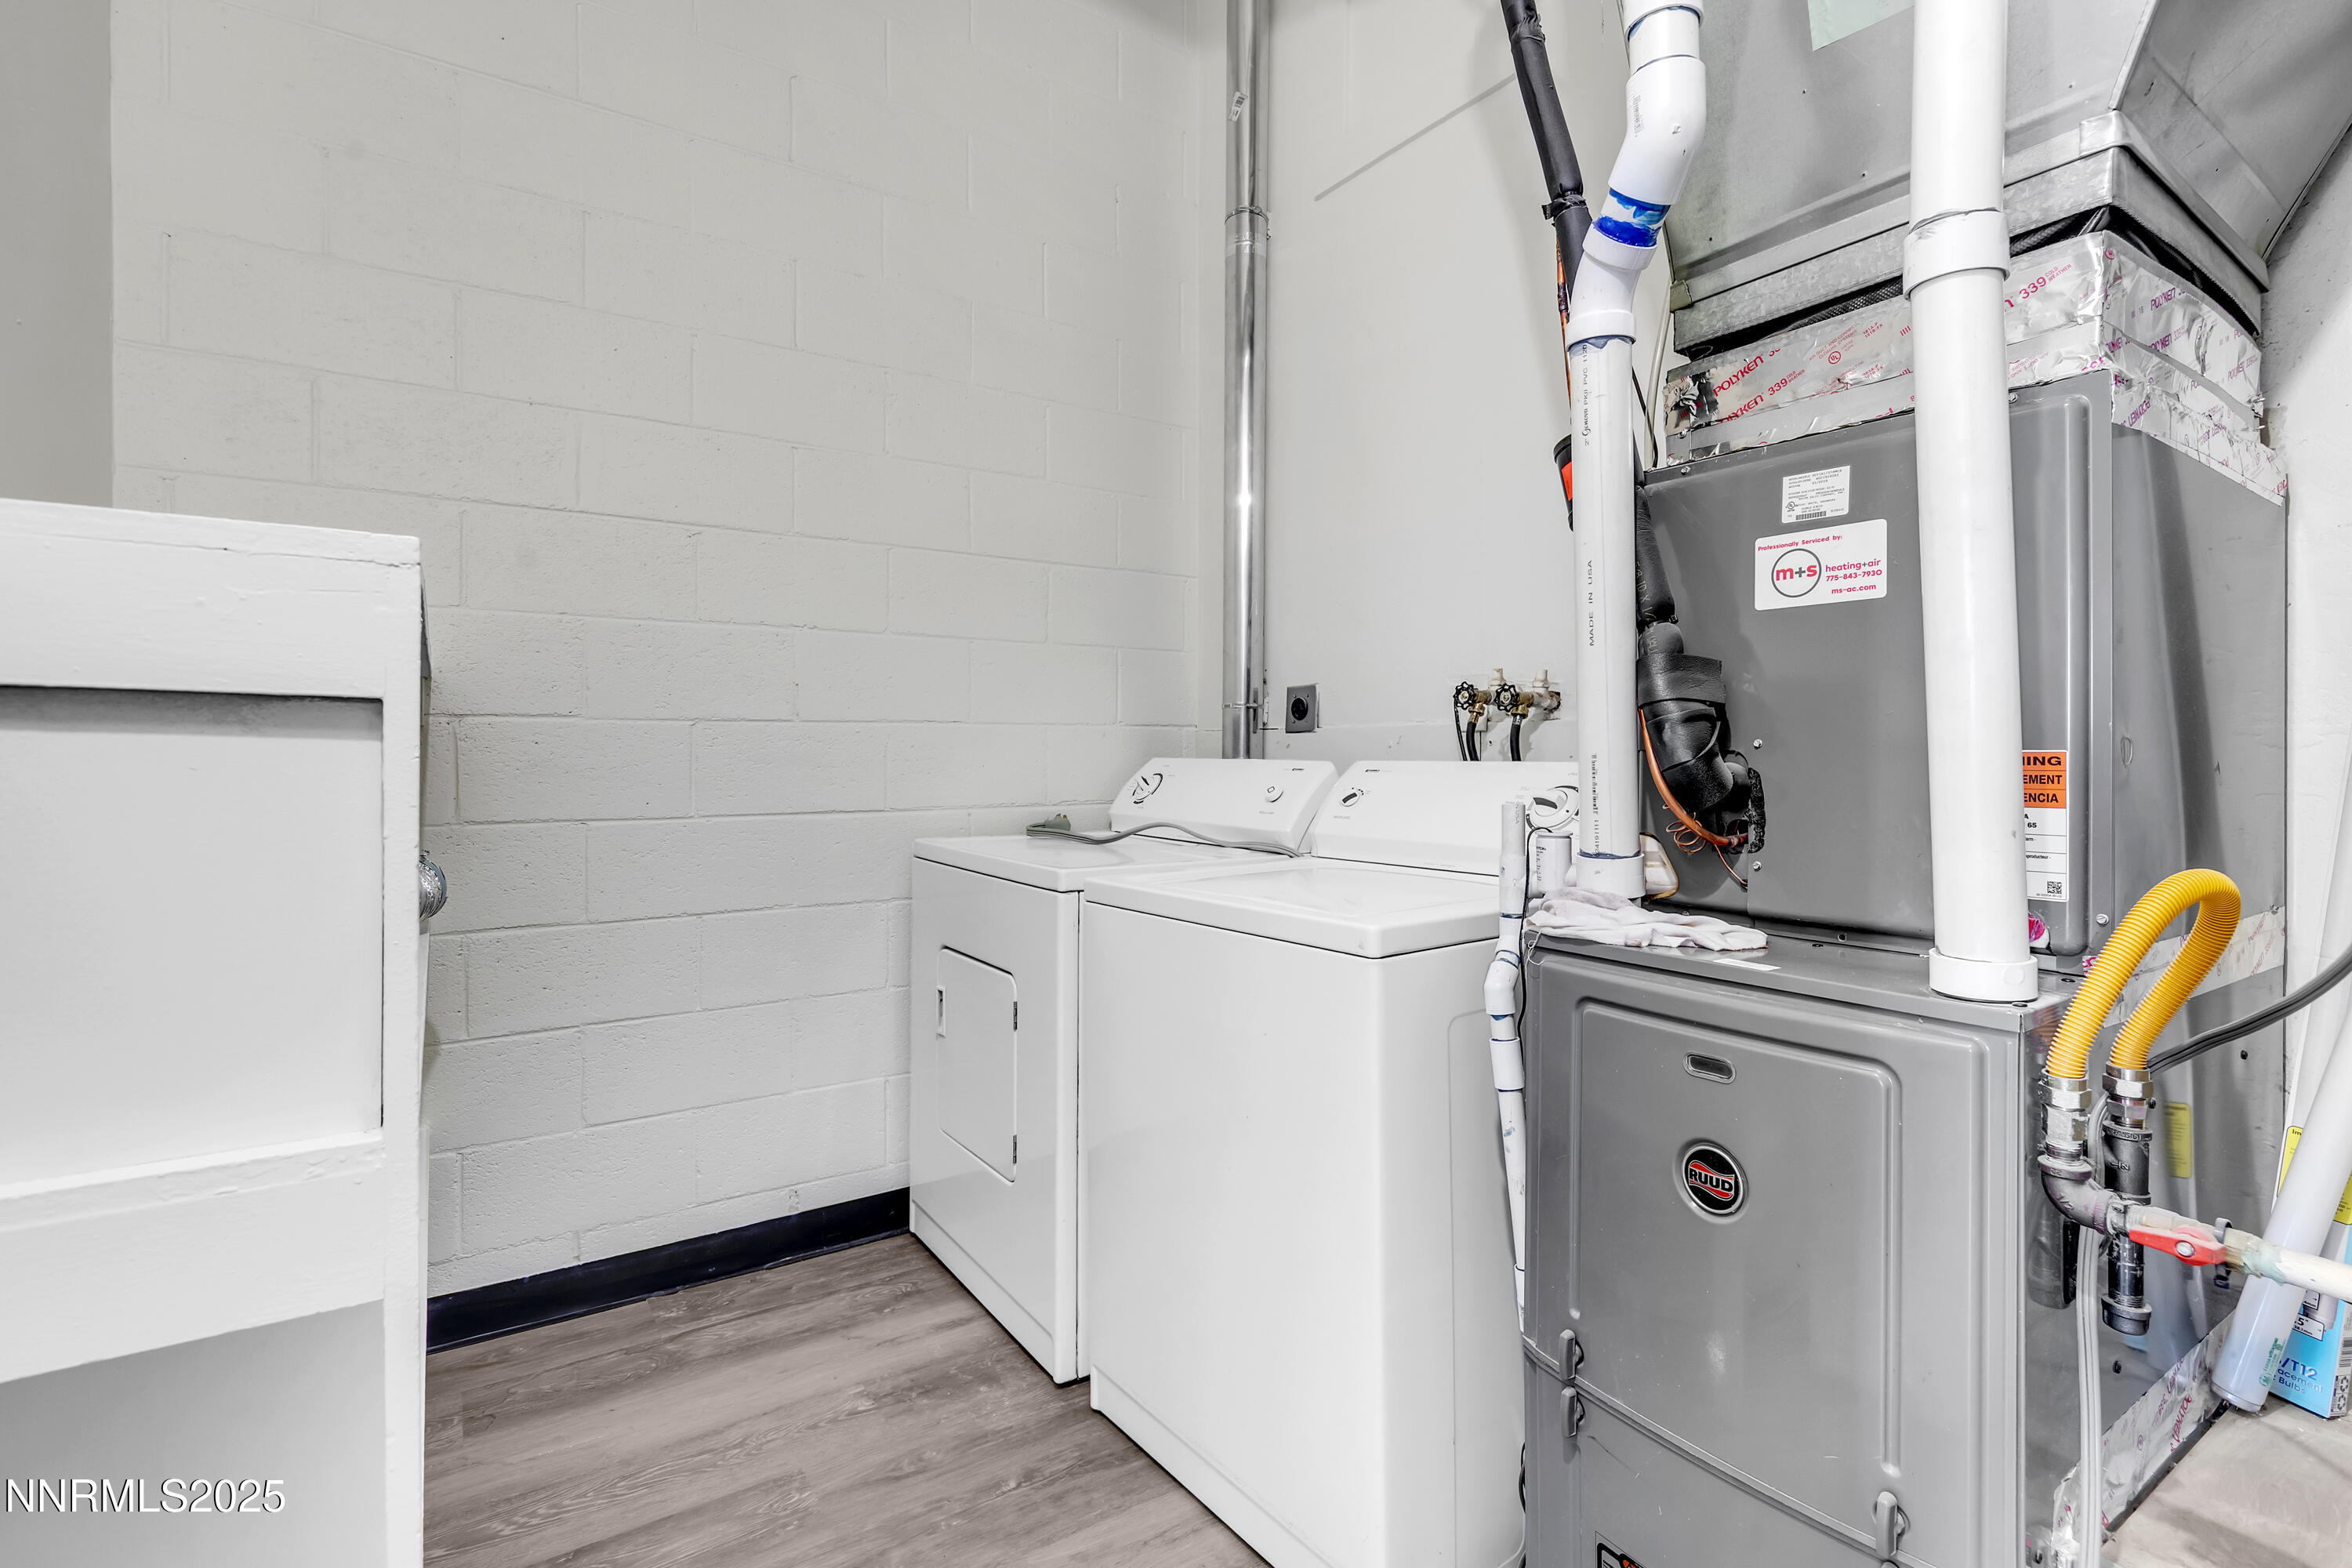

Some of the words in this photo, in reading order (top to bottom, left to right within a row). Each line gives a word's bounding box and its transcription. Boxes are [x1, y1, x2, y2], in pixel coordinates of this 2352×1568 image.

[2020, 276, 2046, 299] 339
[1767, 379, 1788, 396] 339
[1758, 541, 1798, 551] Professionally
[1802, 535, 1830, 545] Serviced
[1776, 564, 1817, 581] m+s
[1825, 558, 1881, 572] heating+air
[1826, 569, 1882, 582] 775-843-7930
[1831, 584, 1877, 594] ms-ac.com
[1588, 592, 1593, 604] IN
[2024, 775, 2062, 784] EMENT
[2024, 793, 2059, 803] ENCIA
[1690, 1168, 1733, 1192] RUUD
[2280, 1357, 2317, 1380] /T12
